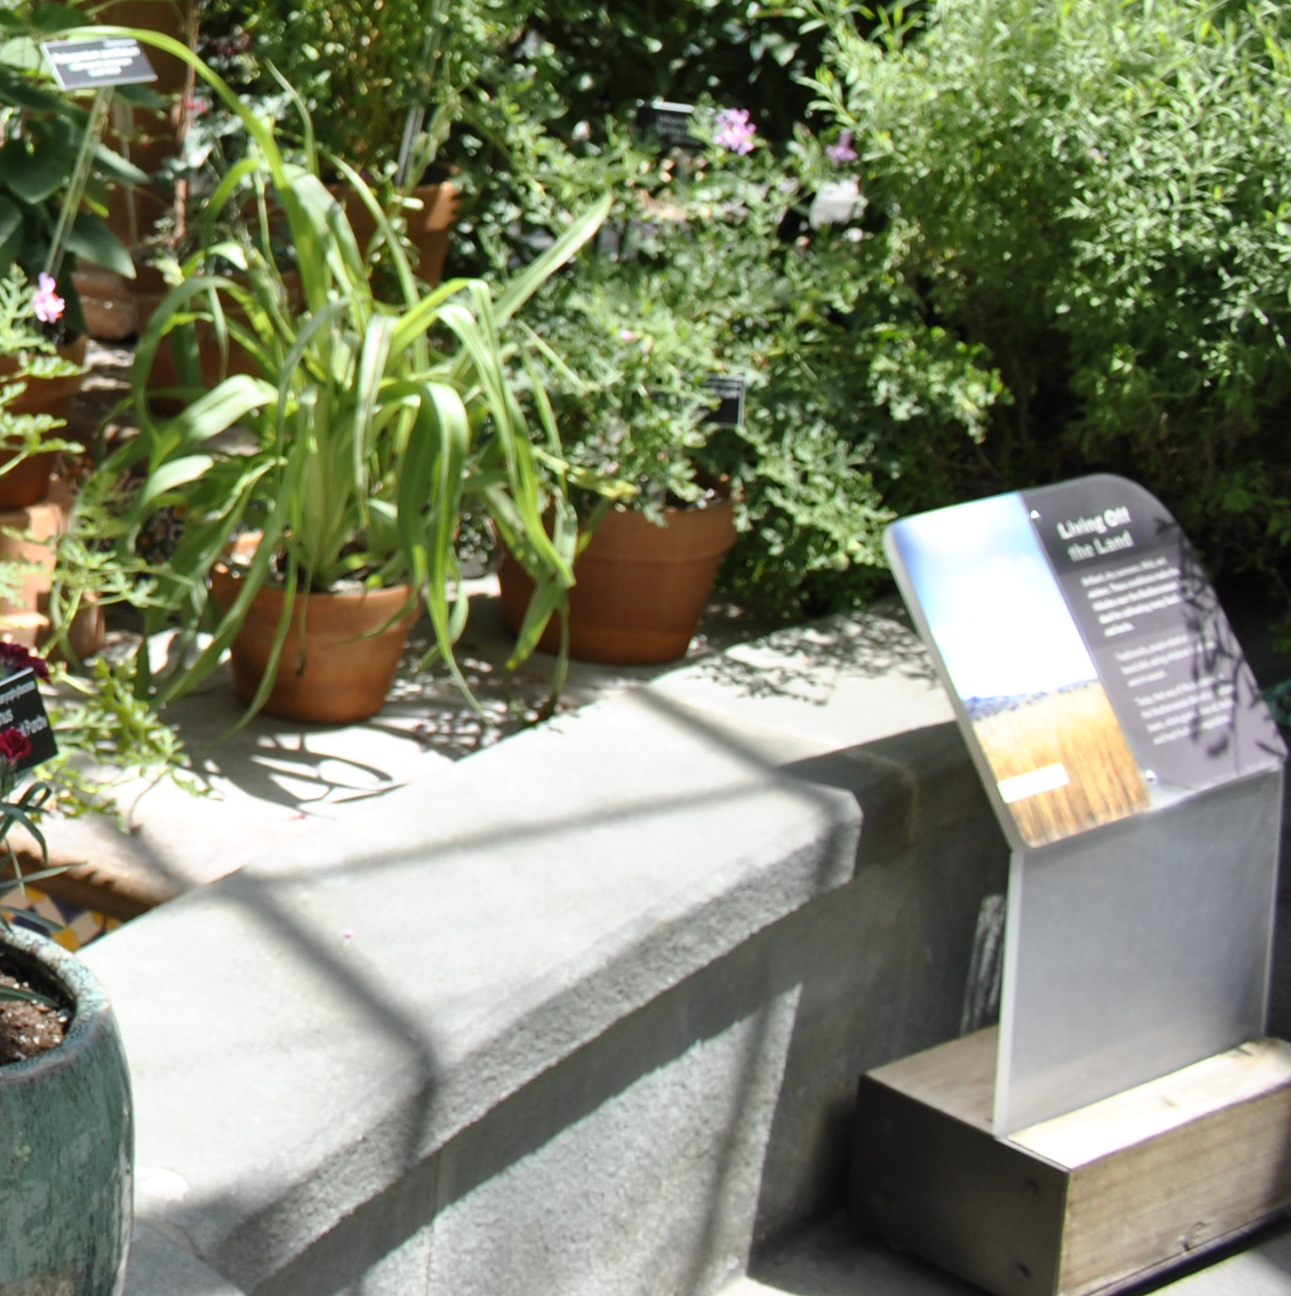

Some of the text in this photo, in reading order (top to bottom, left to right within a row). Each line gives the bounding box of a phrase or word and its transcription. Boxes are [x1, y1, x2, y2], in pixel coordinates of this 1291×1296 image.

[1056, 515, 1107, 539] Living
[1067, 529, 1134, 562] the Land
